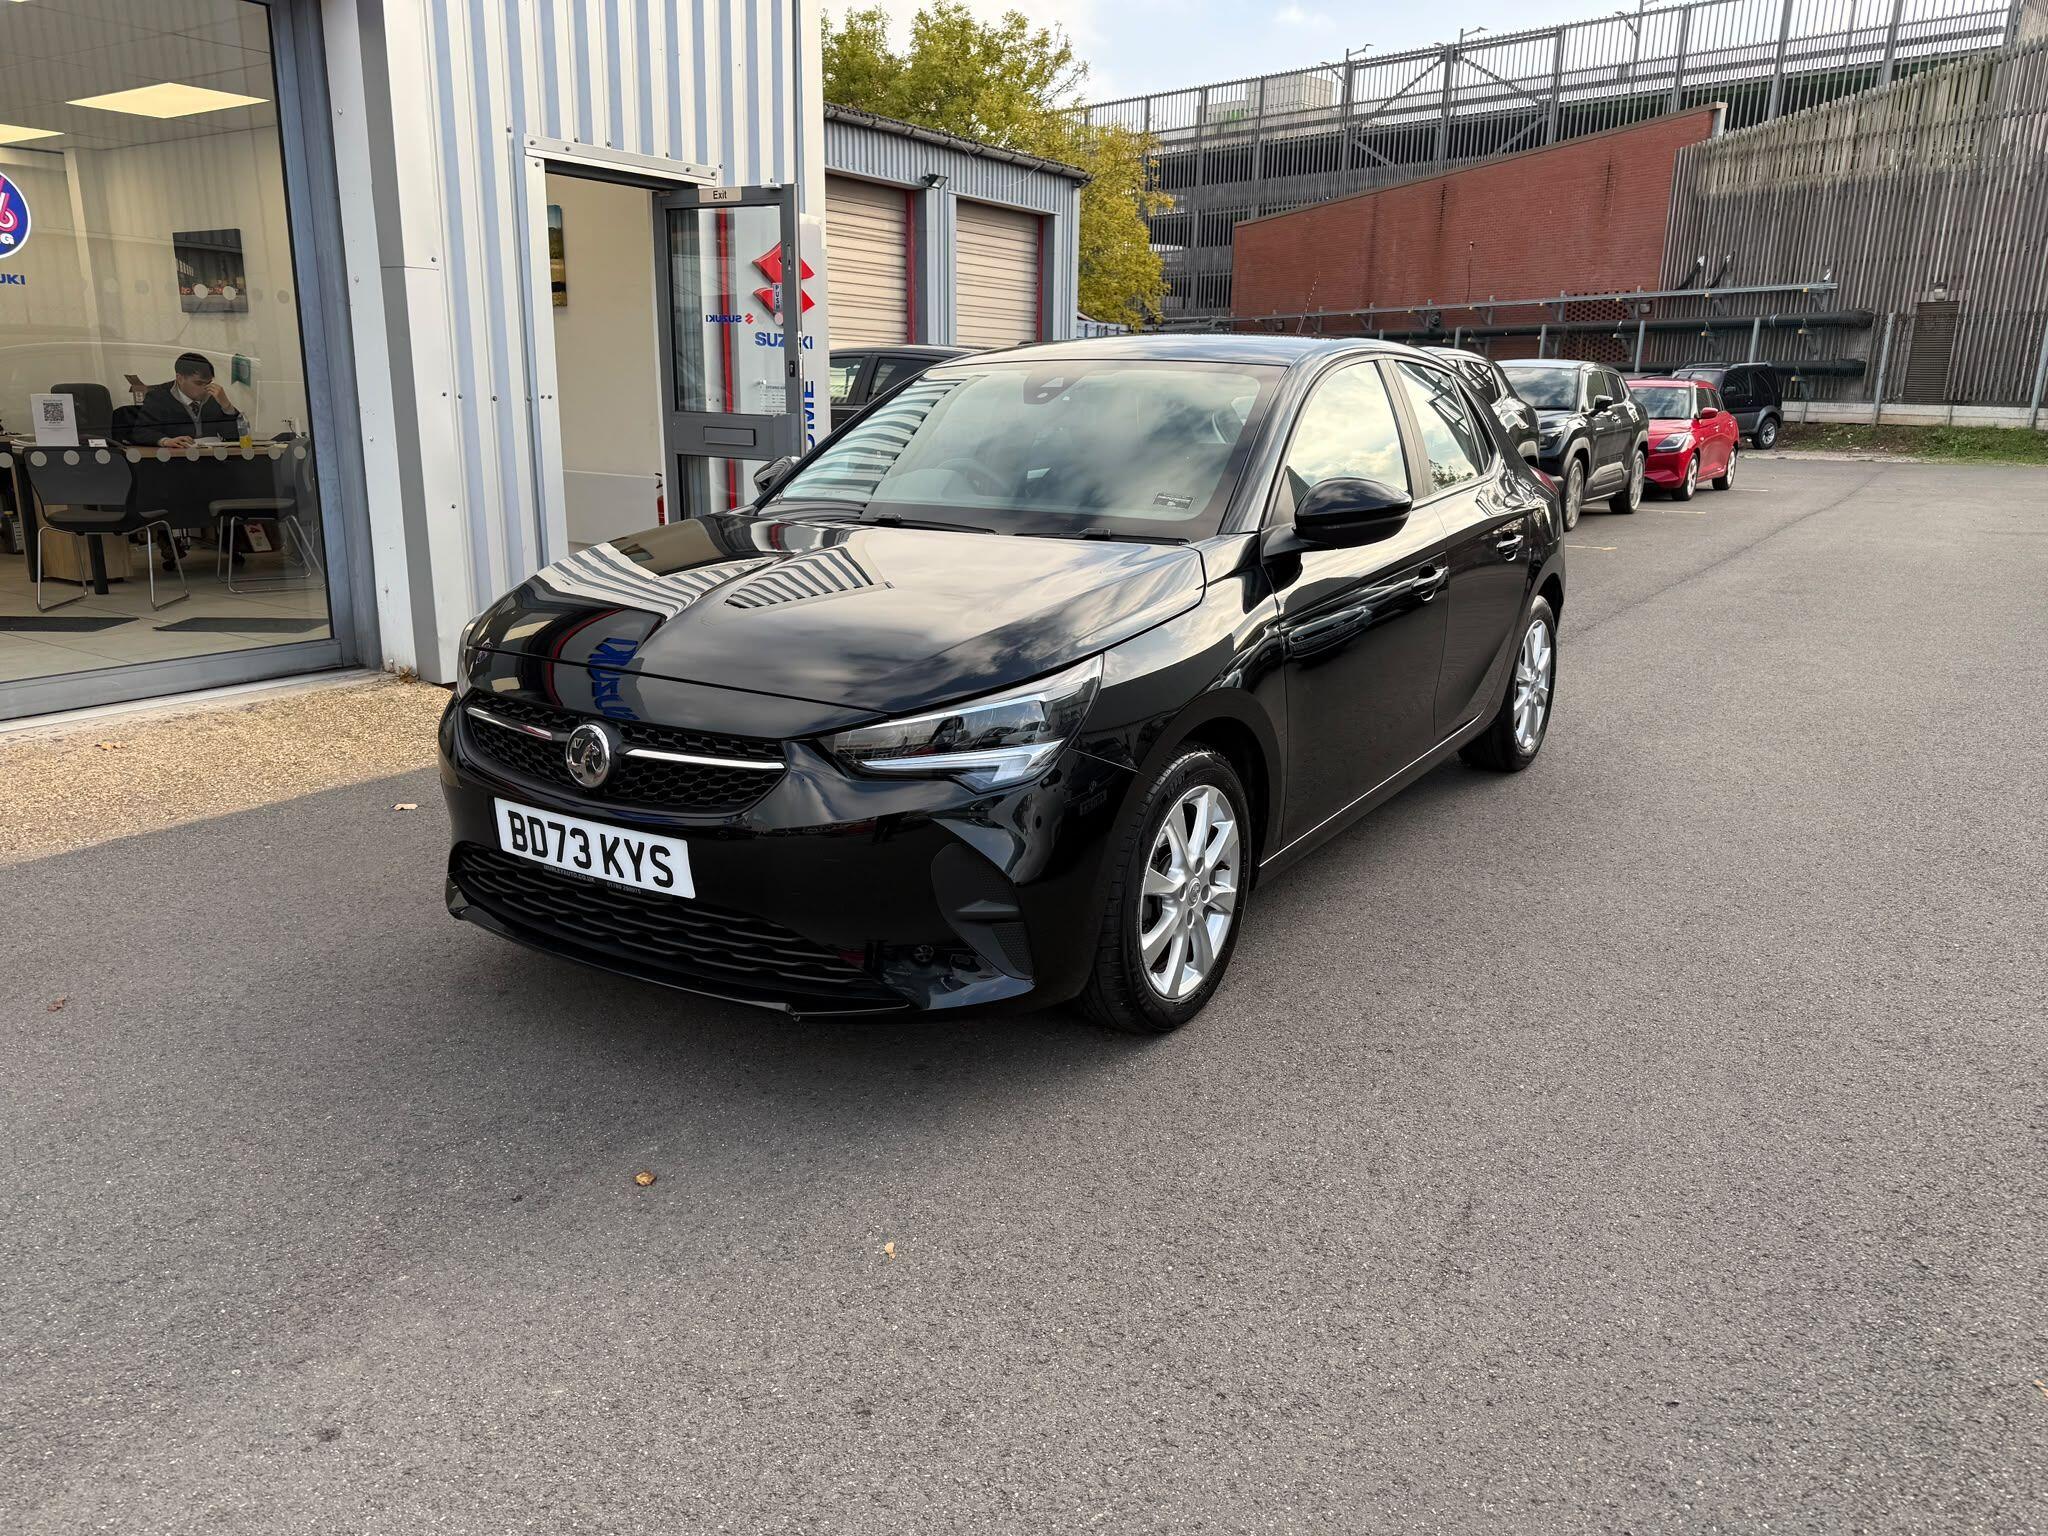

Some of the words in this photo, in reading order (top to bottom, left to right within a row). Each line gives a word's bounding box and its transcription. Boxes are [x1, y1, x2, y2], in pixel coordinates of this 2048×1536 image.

[712, 190, 727, 200] Exit
[754, 331, 813, 350] SUZKI
[507, 810, 592, 870] BD73
[599, 833, 674, 888] KYS
